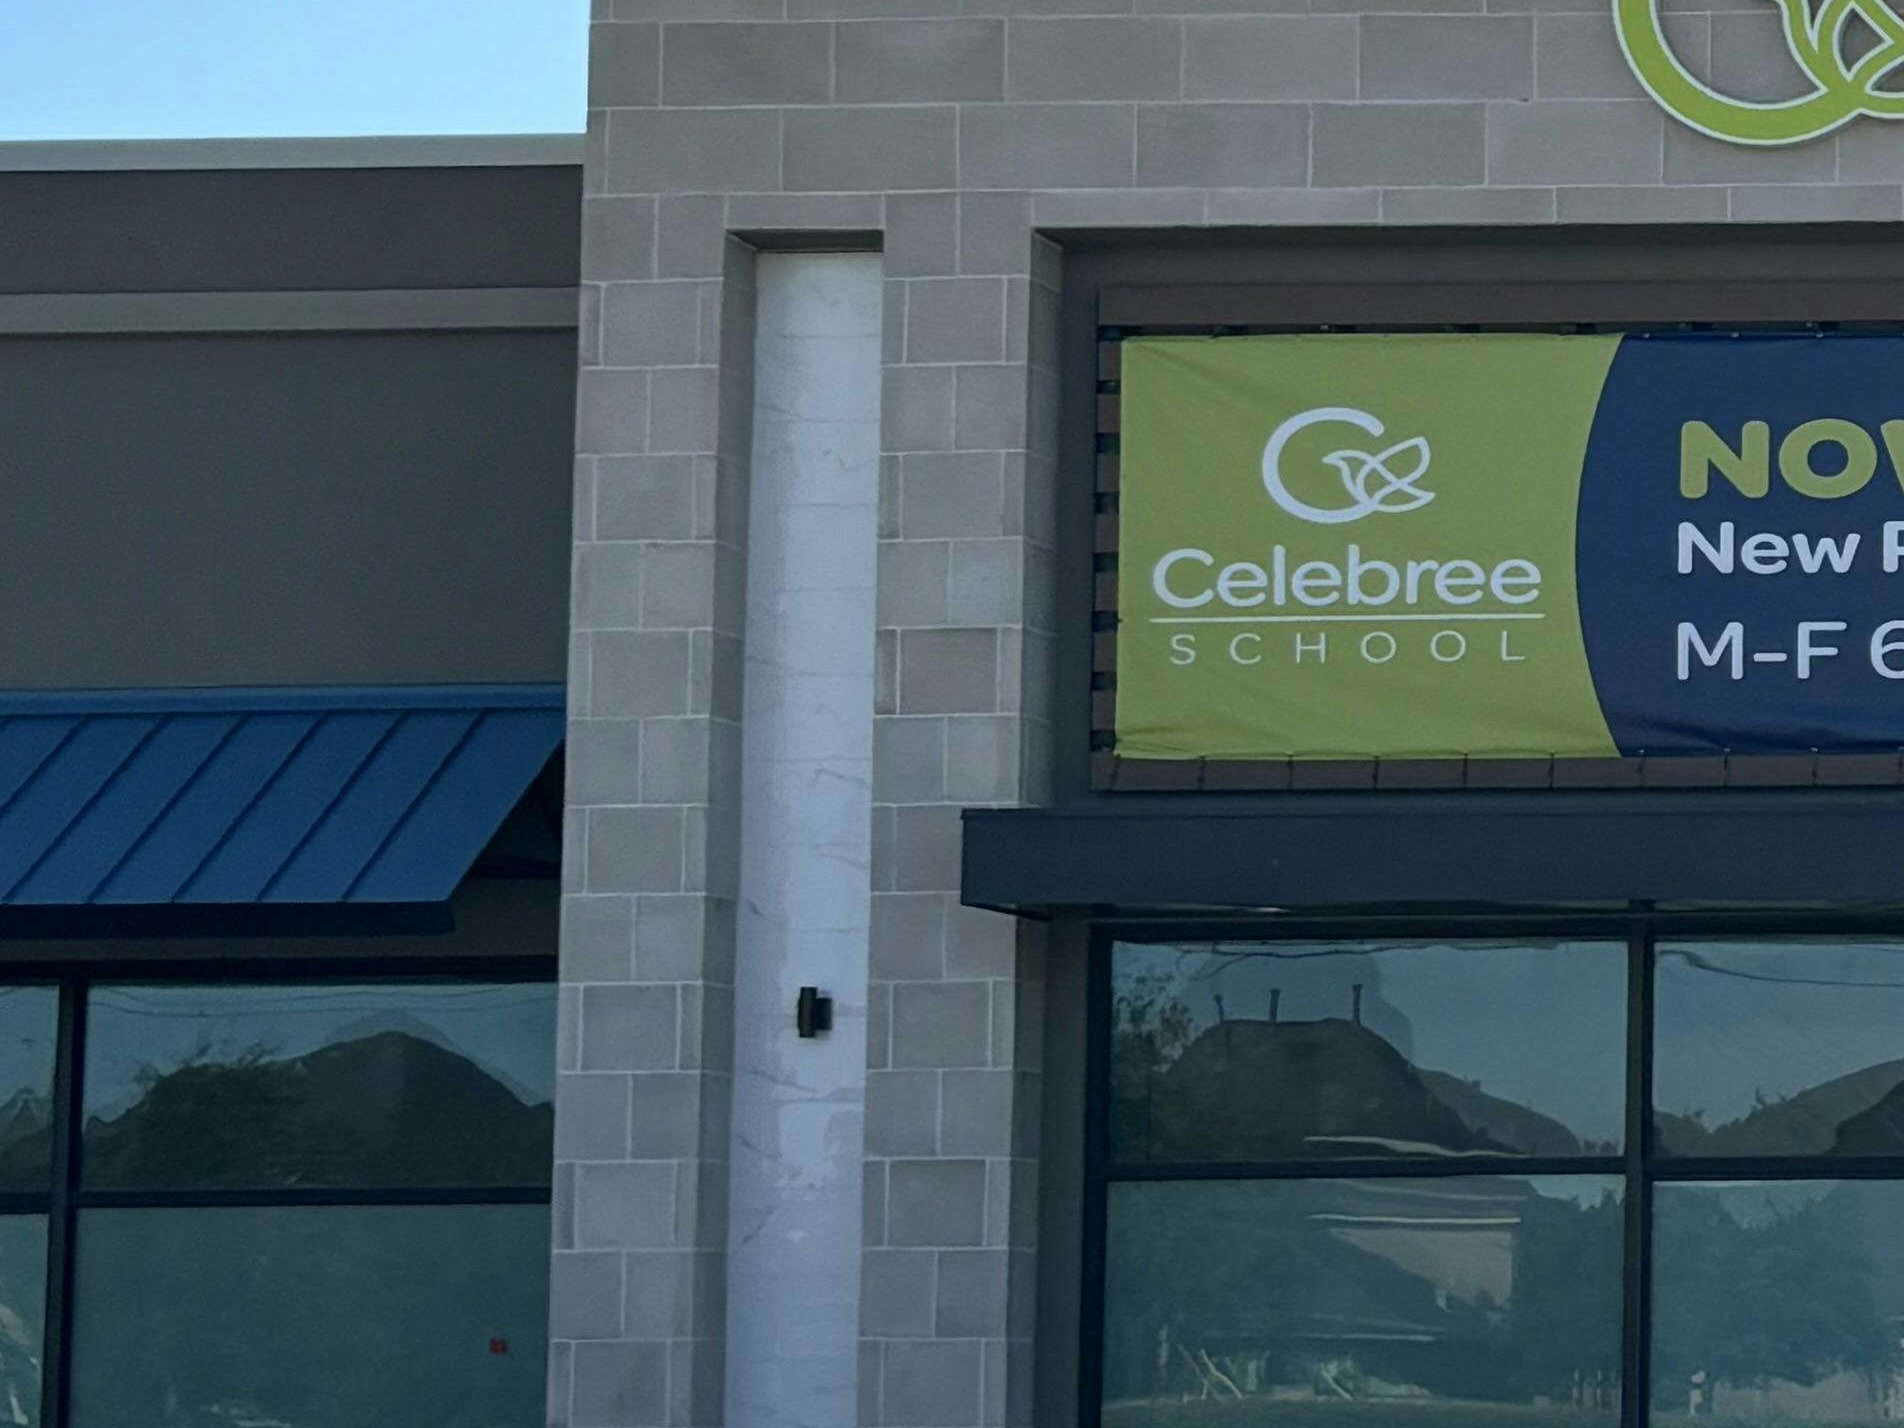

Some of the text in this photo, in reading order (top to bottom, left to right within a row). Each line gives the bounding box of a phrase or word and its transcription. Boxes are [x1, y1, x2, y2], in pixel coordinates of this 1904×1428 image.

[1152, 544, 1542, 608] Celebree
[1677, 521, 1861, 575] New
[1168, 630, 1526, 665] SCHOOL
[1677, 621, 1848, 681] M-F
